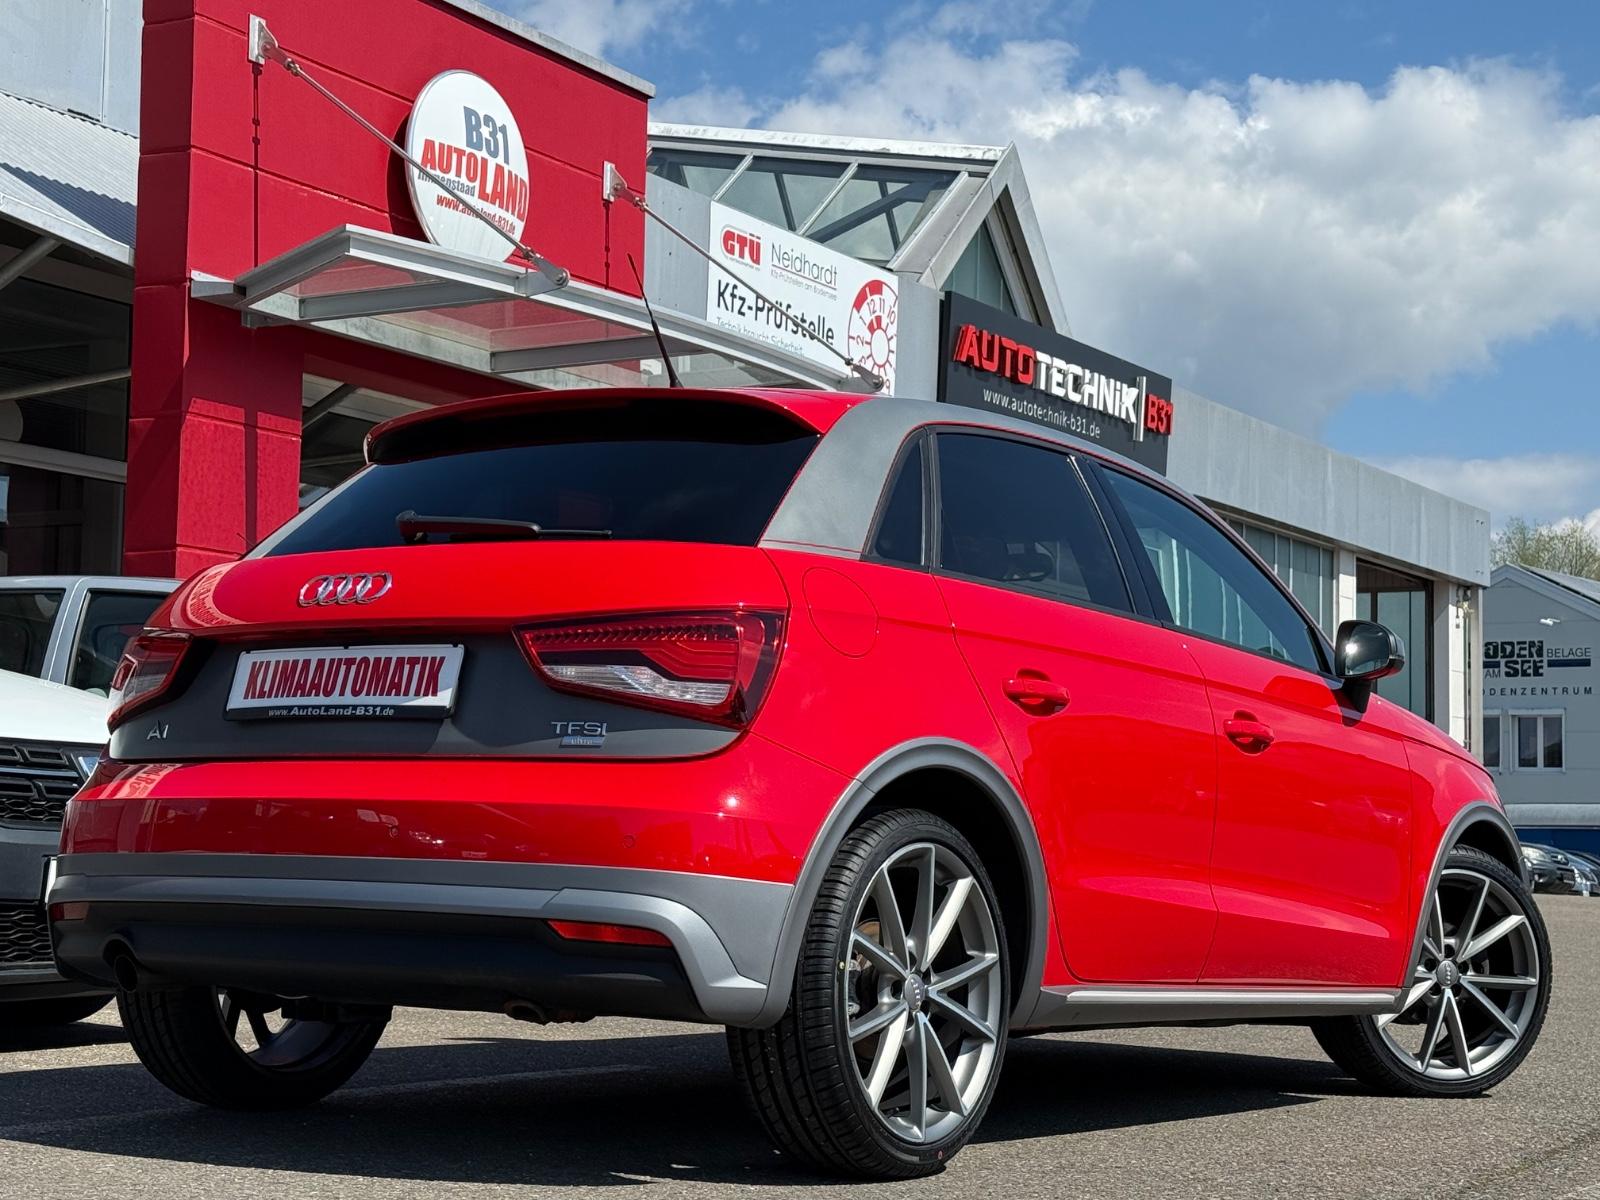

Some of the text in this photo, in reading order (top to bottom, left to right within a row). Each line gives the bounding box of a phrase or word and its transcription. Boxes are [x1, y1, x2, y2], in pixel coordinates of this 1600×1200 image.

[463, 105, 510, 166] B31
[417, 168, 476, 198] Imenstaad
[420, 138, 529, 222] AUTOLAND
[722, 229, 762, 266] GTÜ
[771, 242, 838, 287] Neidhardt
[716, 279, 835, 346] Kfz-Prüfstelle
[867, 298, 877, 316] 12
[878, 297, 886, 314] 11
[887, 305, 896, 325] 10
[983, 388, 1101, 439] www.autotechnik-b31.de
[1146, 393, 1174, 436] B31
[1483, 640, 1592, 659] ODEN BELAGE
[243, 655, 447, 700] KLIMAAUTOMATIK
[1484, 659, 1544, 679] AM SEE
[1482, 686, 1593, 697] DENZENTRUM
[268, 705, 395, 717] www.AutoLand-B31.de
[146, 723, 169, 740] A1
[551, 721, 607, 736] TFSI
